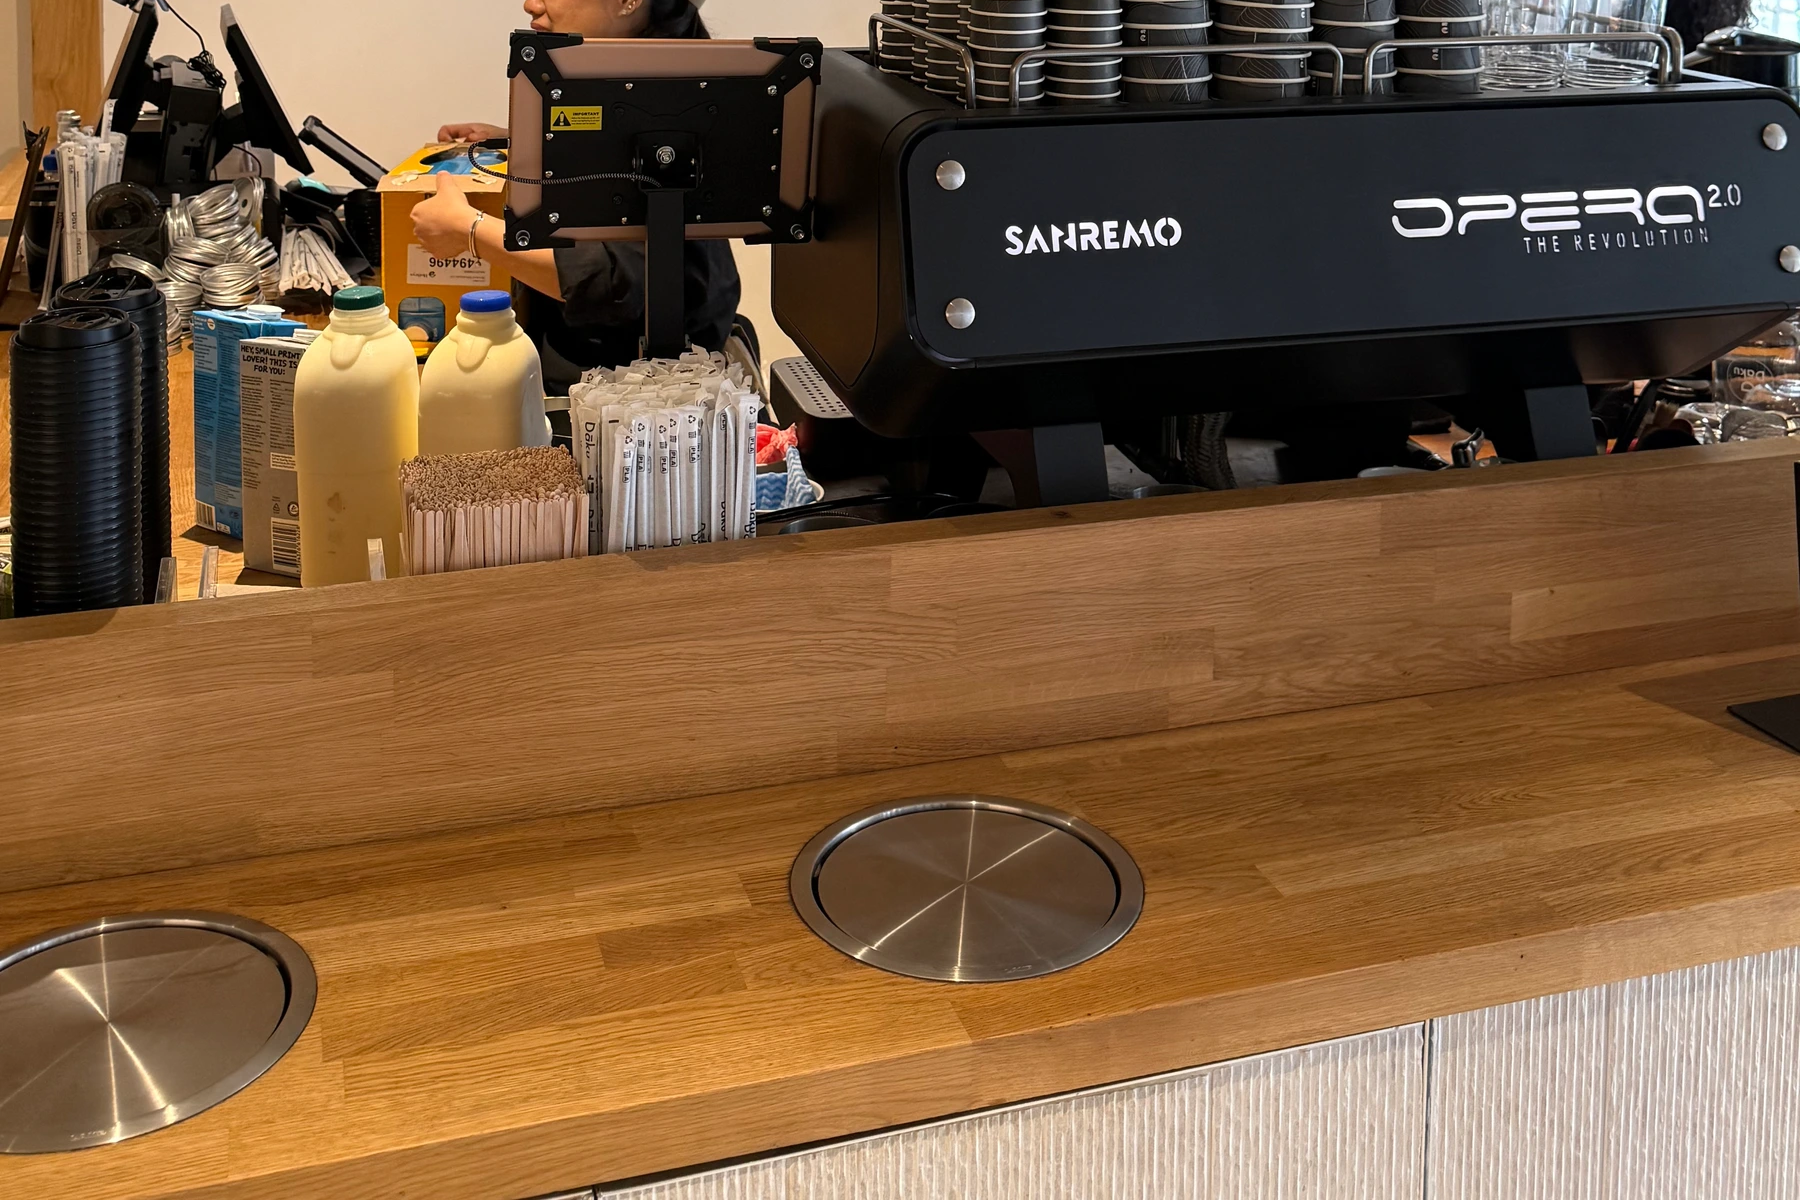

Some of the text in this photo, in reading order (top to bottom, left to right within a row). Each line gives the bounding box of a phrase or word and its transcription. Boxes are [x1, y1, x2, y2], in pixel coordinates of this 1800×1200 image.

[1707, 183, 1742, 209] 2.0
[1004, 216, 1182, 256] SANREMO
[1523, 227, 1710, 254] THE REVOLUTION
[240, 344, 301, 360] HEY, SMALL PRINT
[242, 354, 298, 369] LOVER! THIS IS
[253, 364, 286, 376] FOR YOU:
[585, 421, 596, 459] Dāku
